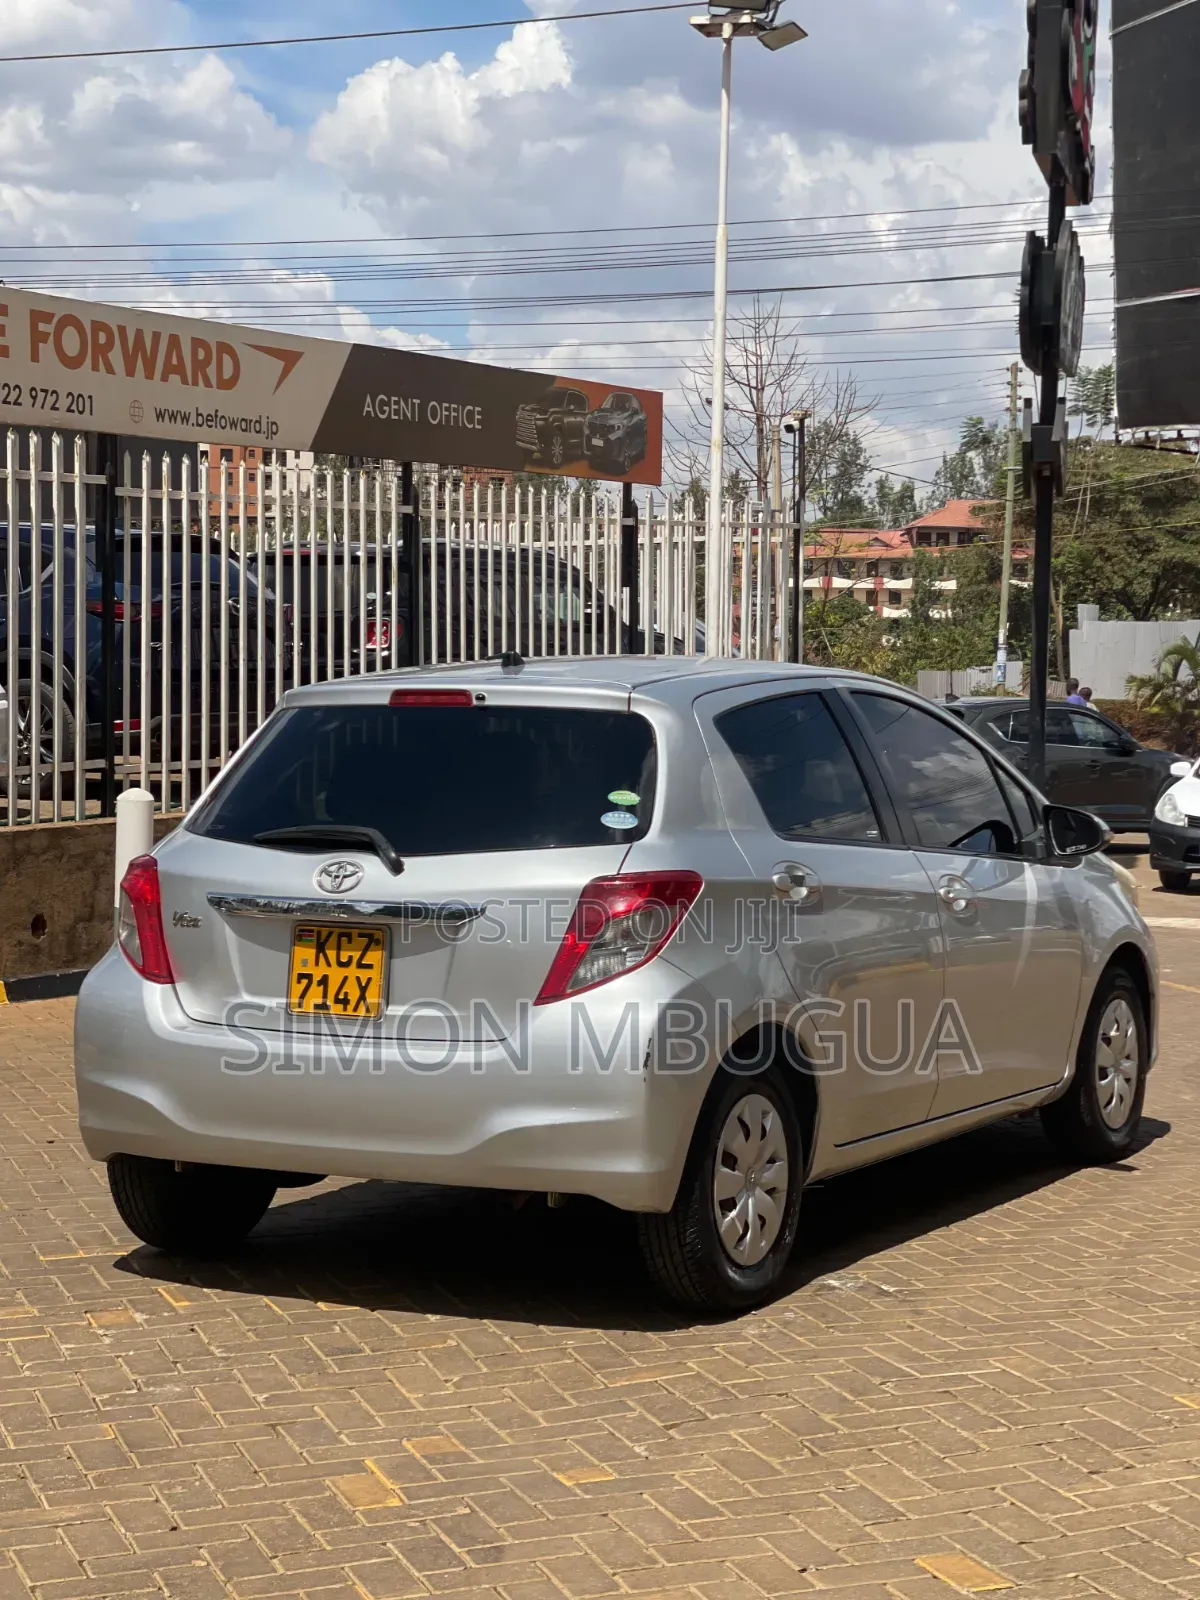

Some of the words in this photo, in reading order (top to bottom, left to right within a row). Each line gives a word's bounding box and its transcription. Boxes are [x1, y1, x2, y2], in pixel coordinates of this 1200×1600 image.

[29, 308, 241, 391] FORWARD
[29, 386, 60, 410] 972
[66, 391, 94, 416] 201
[362, 393, 421, 422] AGENT
[427, 400, 482, 429] OFFICE
[153, 406, 279, 440] www.befoward.jp
[314, 929, 376, 970] KCZ
[296, 972, 373, 1013] 714X
